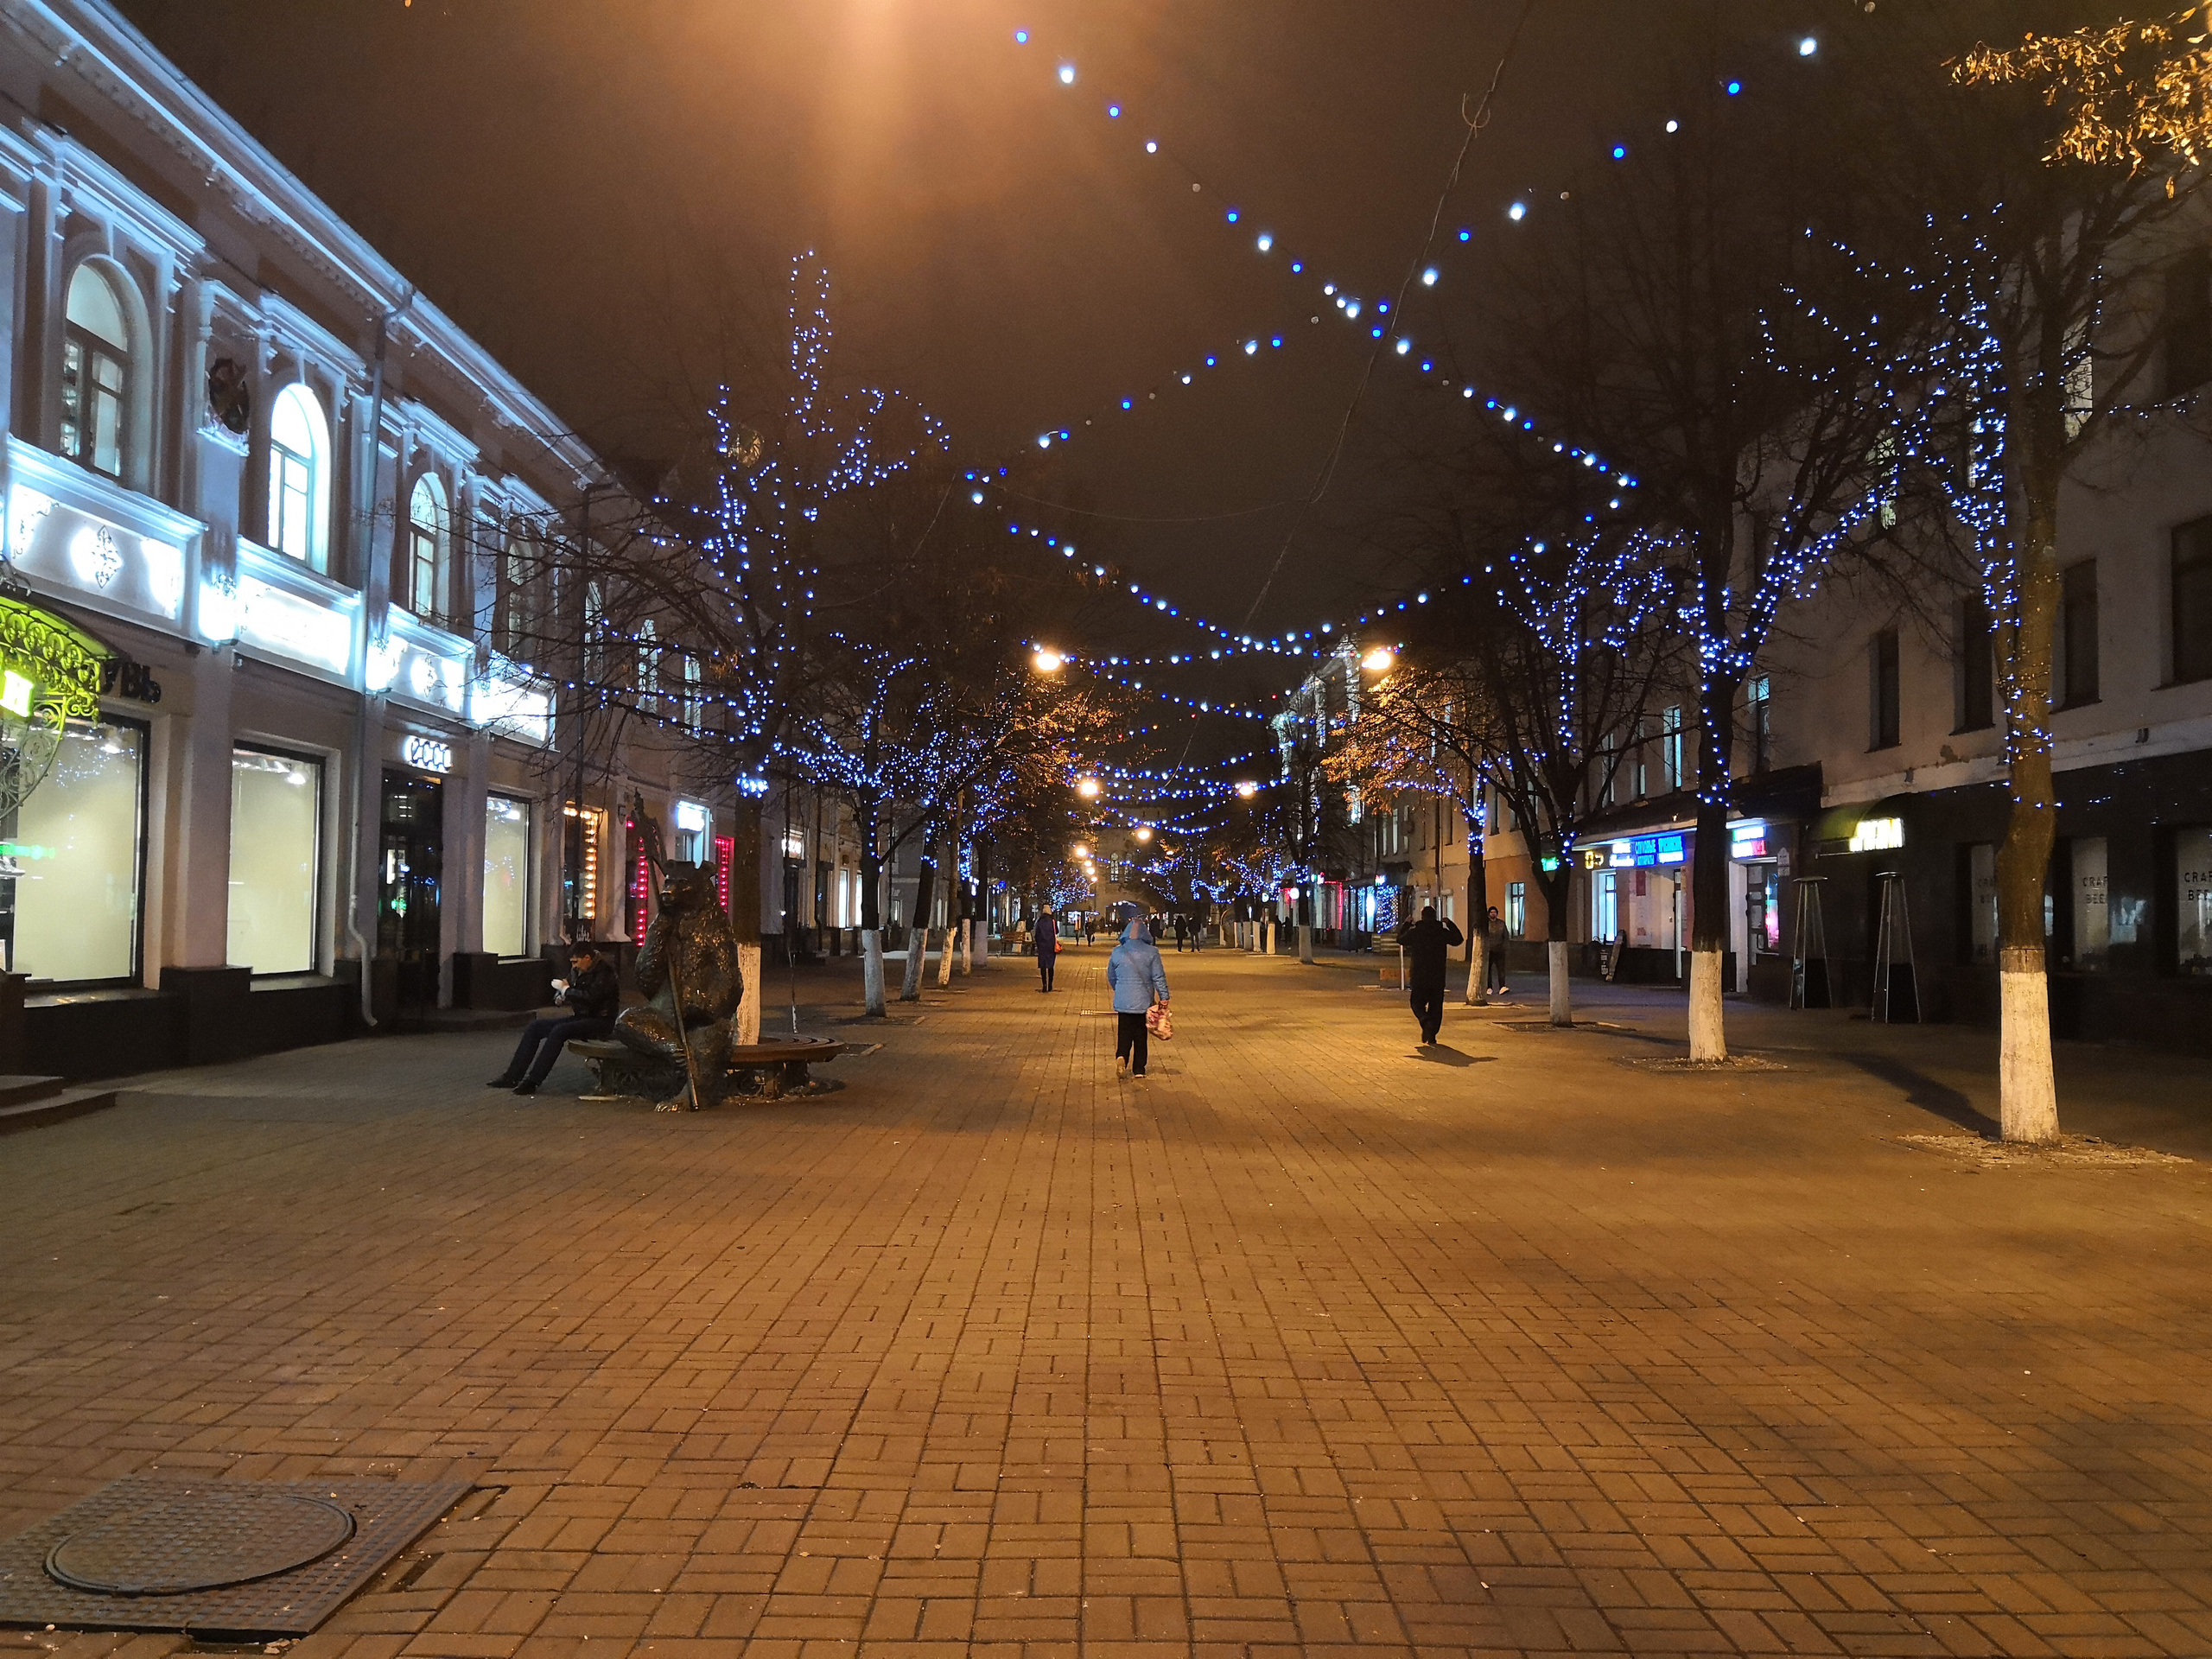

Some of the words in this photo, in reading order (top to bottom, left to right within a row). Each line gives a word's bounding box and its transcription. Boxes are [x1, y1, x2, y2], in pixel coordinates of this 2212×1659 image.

[102, 660, 162, 703] УВЬ
[2082, 876, 2108, 887] CRAF
[2183, 871, 2212, 883] CRAF
[2086, 893, 2105, 905] BEE
[2188, 889, 2210, 901] BEE
